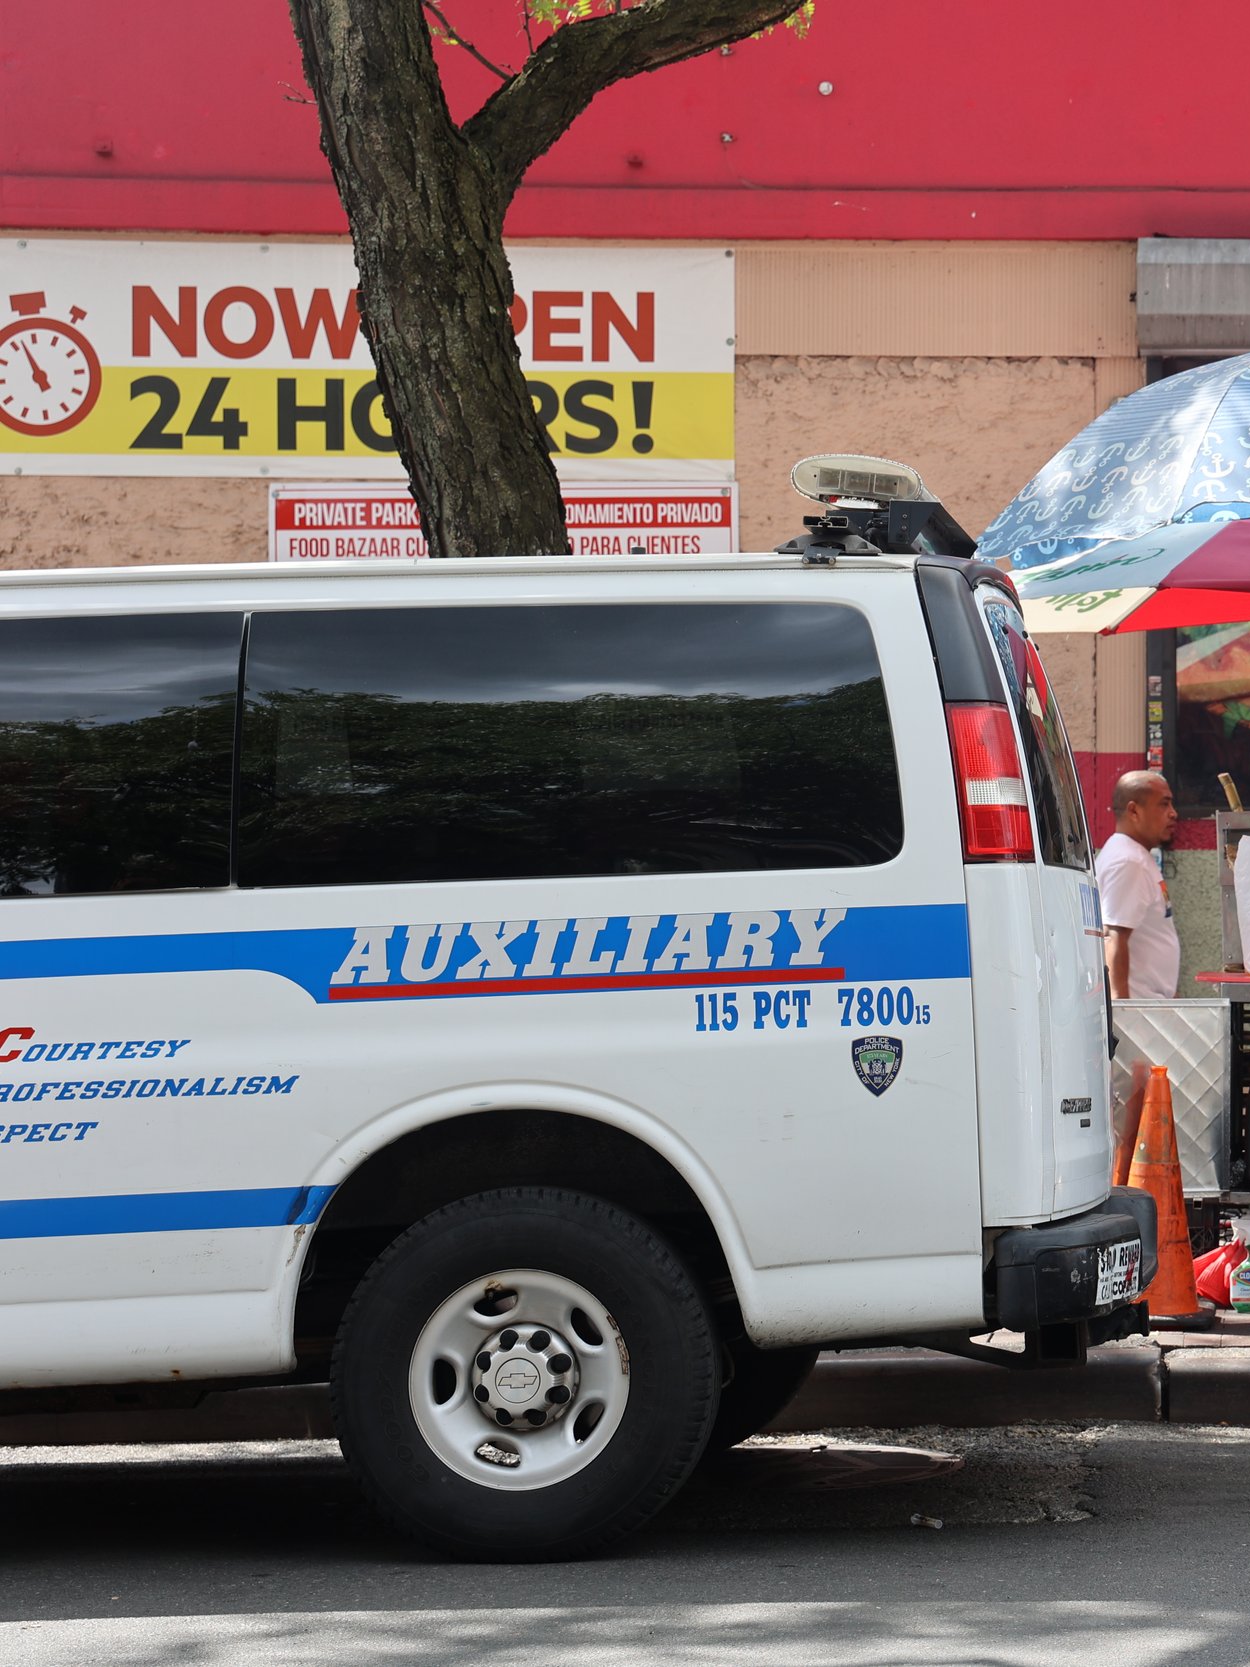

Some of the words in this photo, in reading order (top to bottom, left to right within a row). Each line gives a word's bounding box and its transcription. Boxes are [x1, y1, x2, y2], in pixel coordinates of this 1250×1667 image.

[131, 285, 368, 360] NOW
[506, 291, 655, 363] EN
[128, 375, 249, 450] 24
[294, 502, 366, 526] PRIVATE
[371, 501, 420, 526] PARK
[565, 502, 653, 524] ONAMIENTO
[657, 502, 722, 523] PRIVADO
[289, 537, 330, 557] FOOD
[335, 537, 400, 557] BAZAAR
[580, 536, 622, 555] PARA
[329, 908, 847, 984] AUXILIARY
[695, 992, 739, 1031] 115
[753, 990, 811, 1029] PCT
[854, 1043, 900, 1055] DEPARTMENT
[854, 1060, 865, 1076] CITY
[861, 1076, 870, 1085] OF
[884, 1073, 895, 1087] NEW
[892, 1057, 901, 1073] YORK
